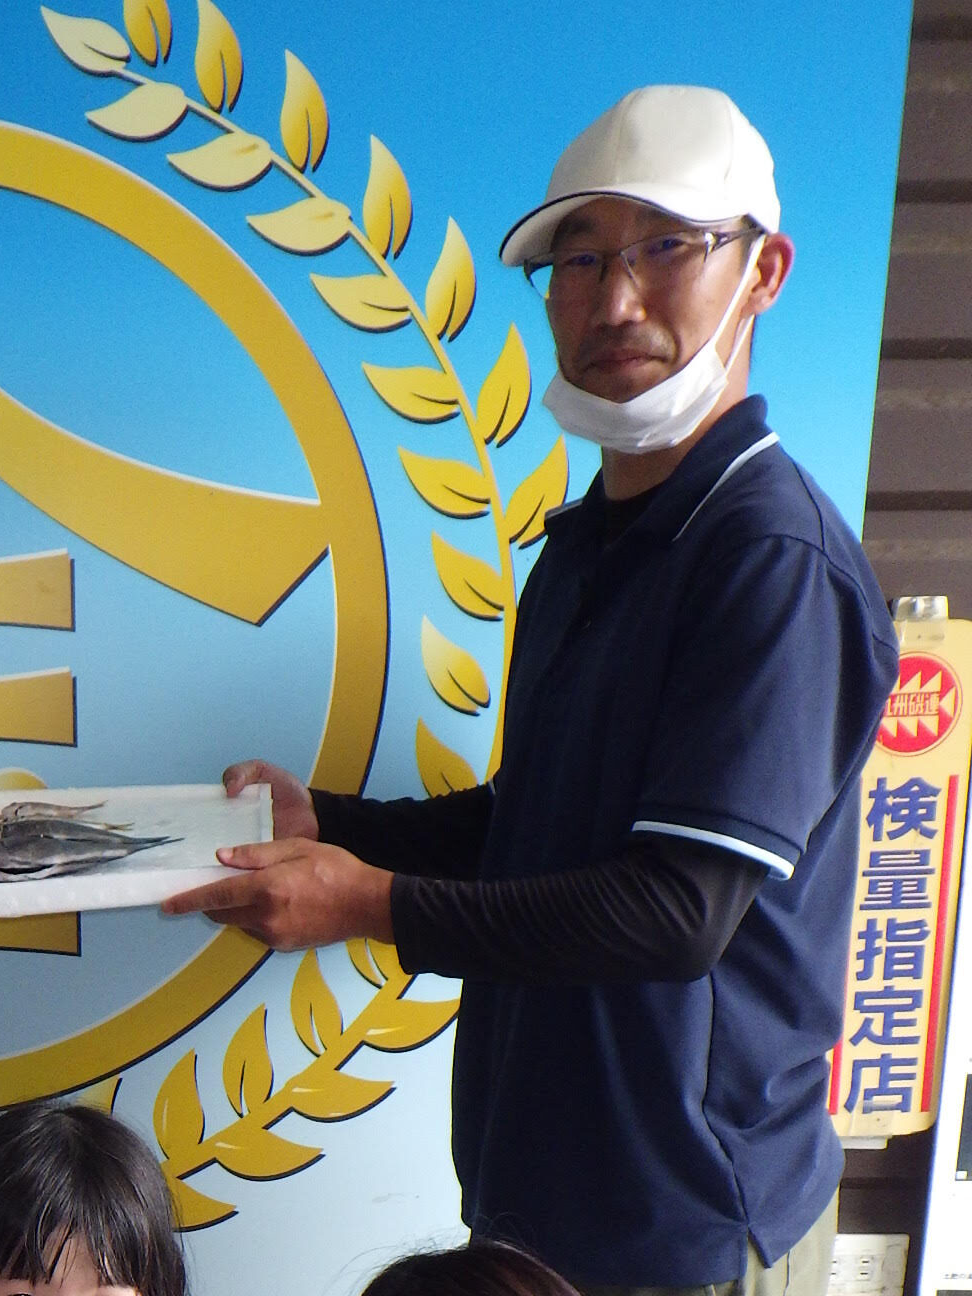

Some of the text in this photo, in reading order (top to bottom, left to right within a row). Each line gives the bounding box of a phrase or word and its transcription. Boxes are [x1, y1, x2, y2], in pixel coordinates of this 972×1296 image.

[844, 777, 942, 1115] 検量指定店
